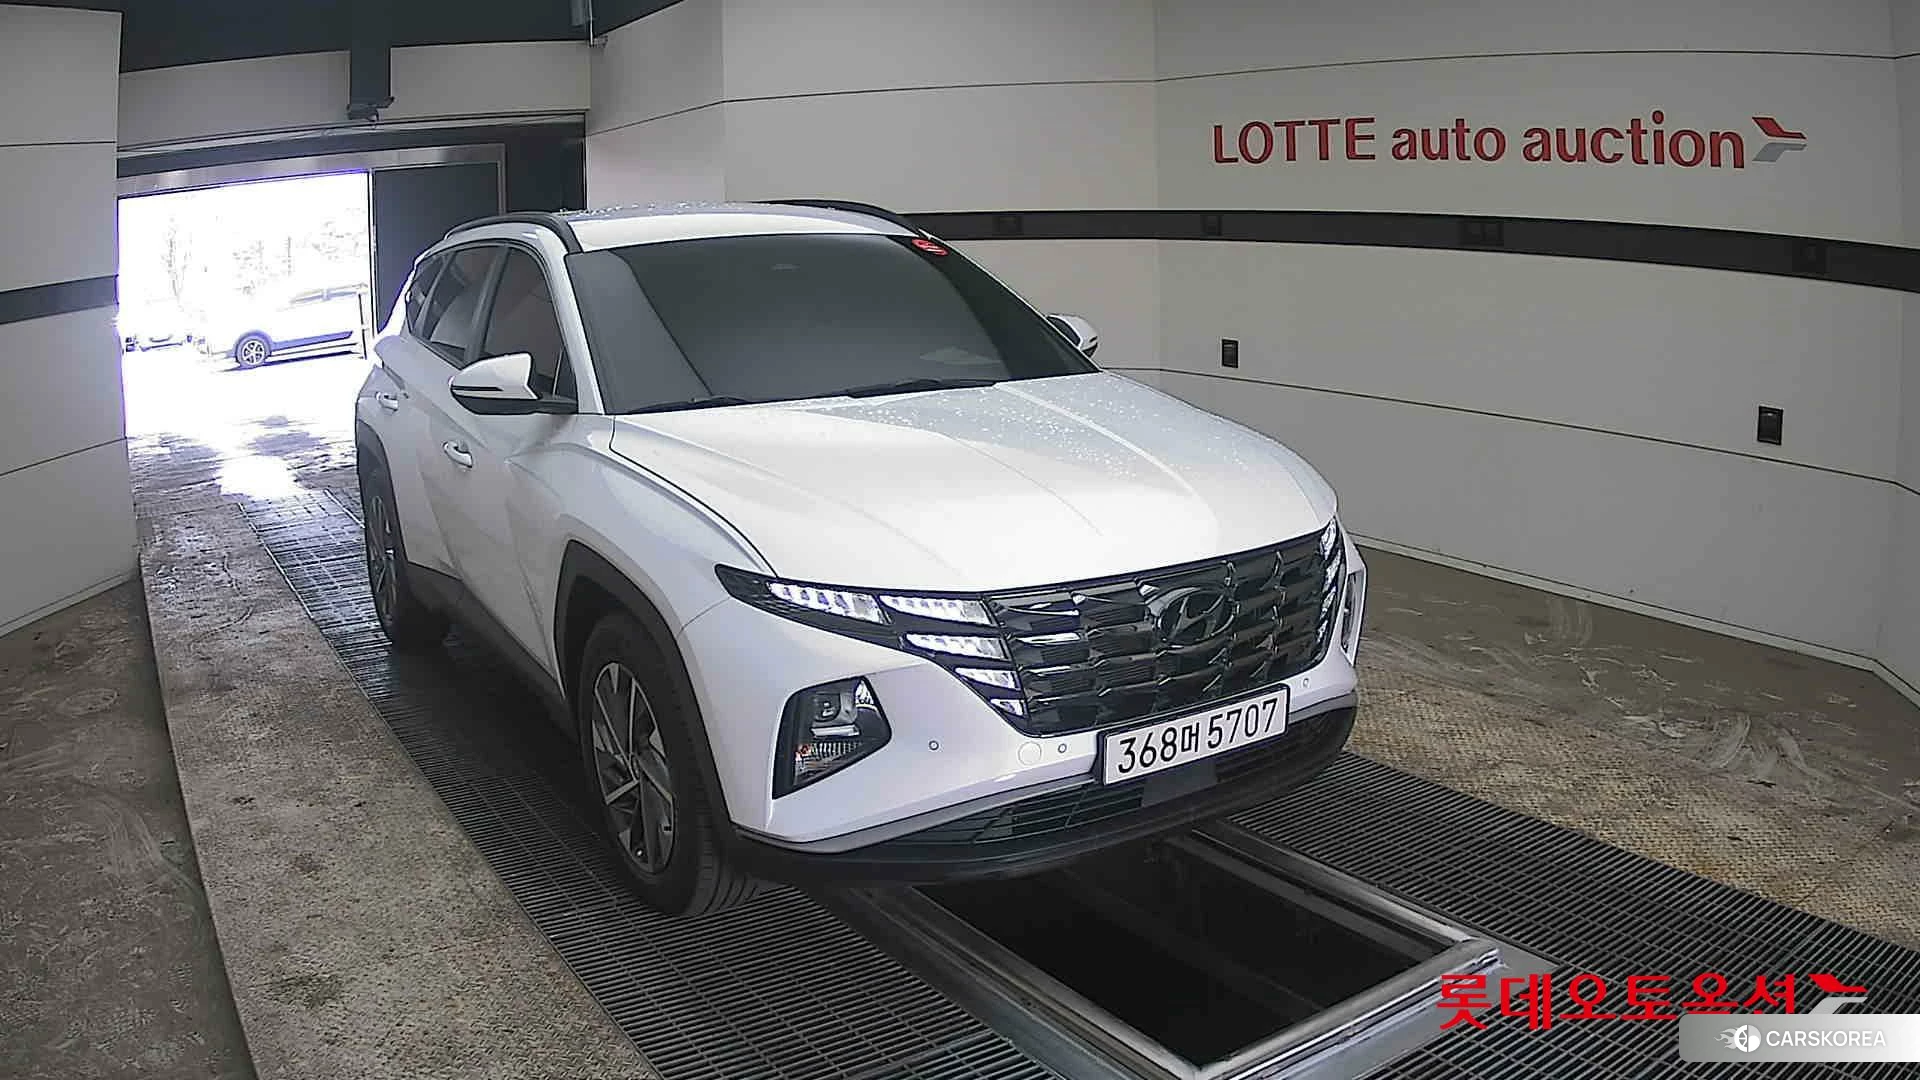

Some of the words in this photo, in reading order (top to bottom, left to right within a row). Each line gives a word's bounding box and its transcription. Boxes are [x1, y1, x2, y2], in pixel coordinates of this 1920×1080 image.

[1212, 116, 1376, 164] LOTTE
[1391, 117, 1507, 162] auto
[1522, 110, 1745, 169] auction
[1117, 721, 1200, 774] 368머
[1207, 697, 1279, 749] 5707
